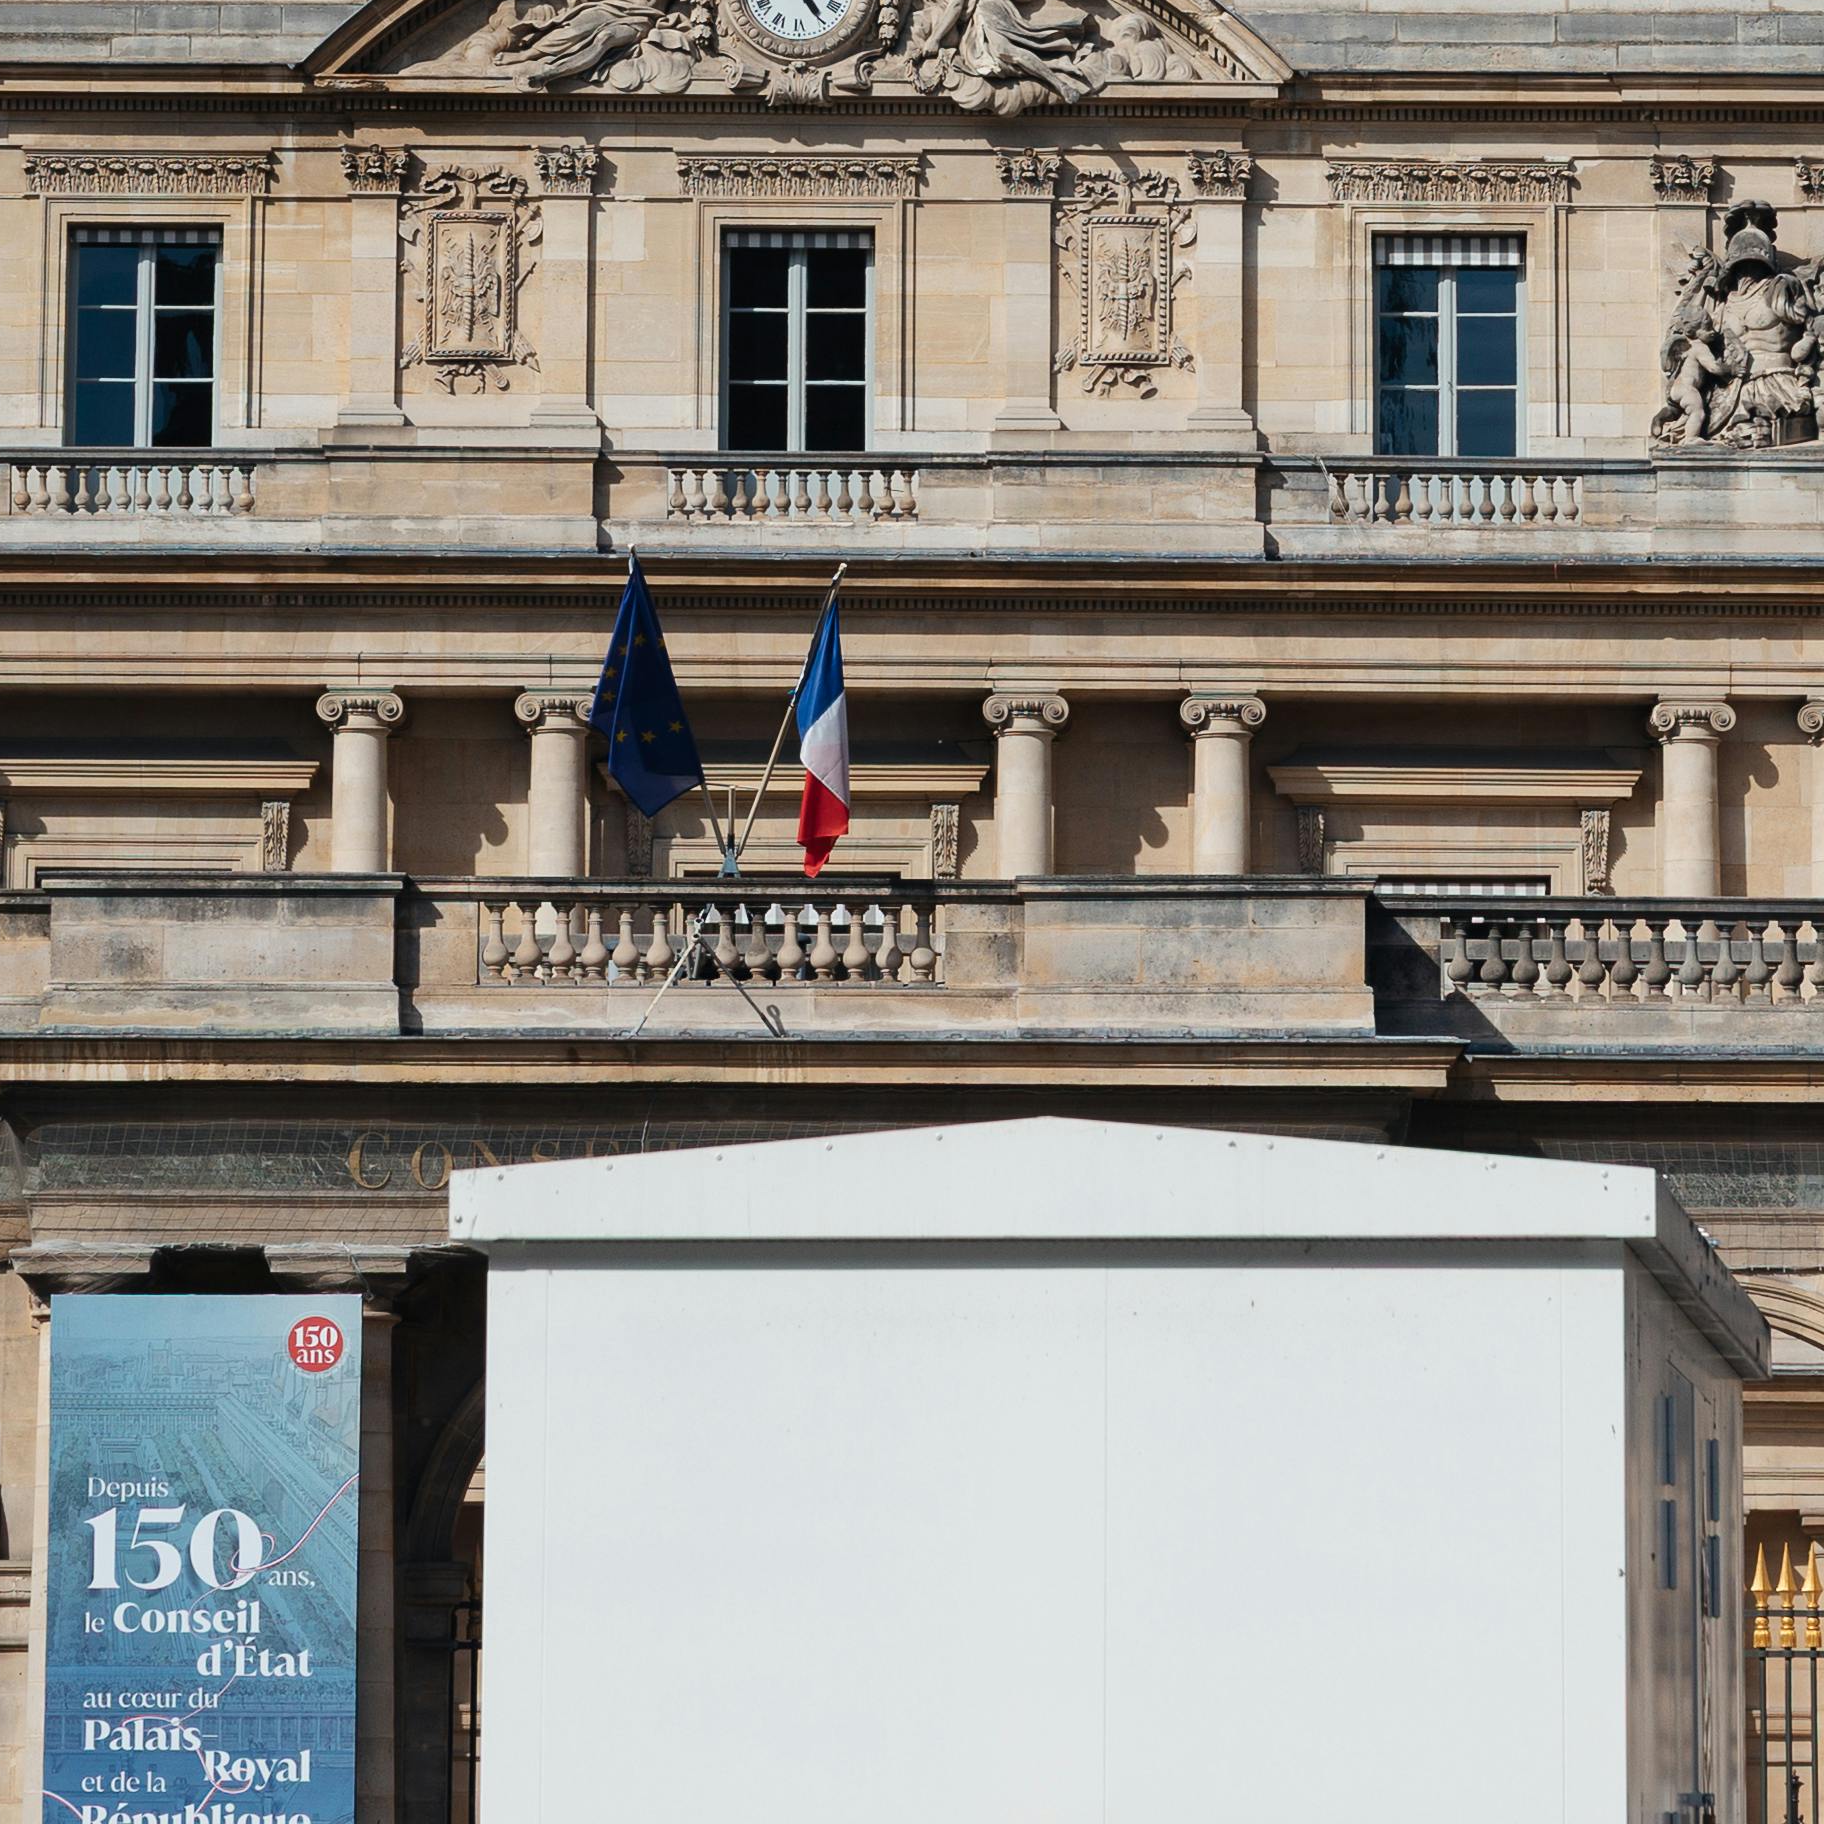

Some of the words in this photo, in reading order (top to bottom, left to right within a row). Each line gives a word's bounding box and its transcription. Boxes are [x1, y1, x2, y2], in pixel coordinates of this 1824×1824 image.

[293, 1325, 339, 1348] 150
[296, 1348, 335, 1364] ans
[87, 1476, 169, 1502] Depuis
[83, 1502, 263, 1590] 150
[268, 1569, 316, 1589] ans,
[84, 1611, 105, 1633] le
[113, 1599, 261, 1633] Conseil
[196, 1636, 314, 1677] d’État
[82, 1691, 112, 1709] au
[118, 1691, 182, 1709] cœur
[188, 1686, 218, 1709] du
[81, 1774, 105, 1793] et
[110, 1771, 140, 1793] de
[146, 1771, 167, 1793] la
[203, 1749, 311, 1791] Royal
